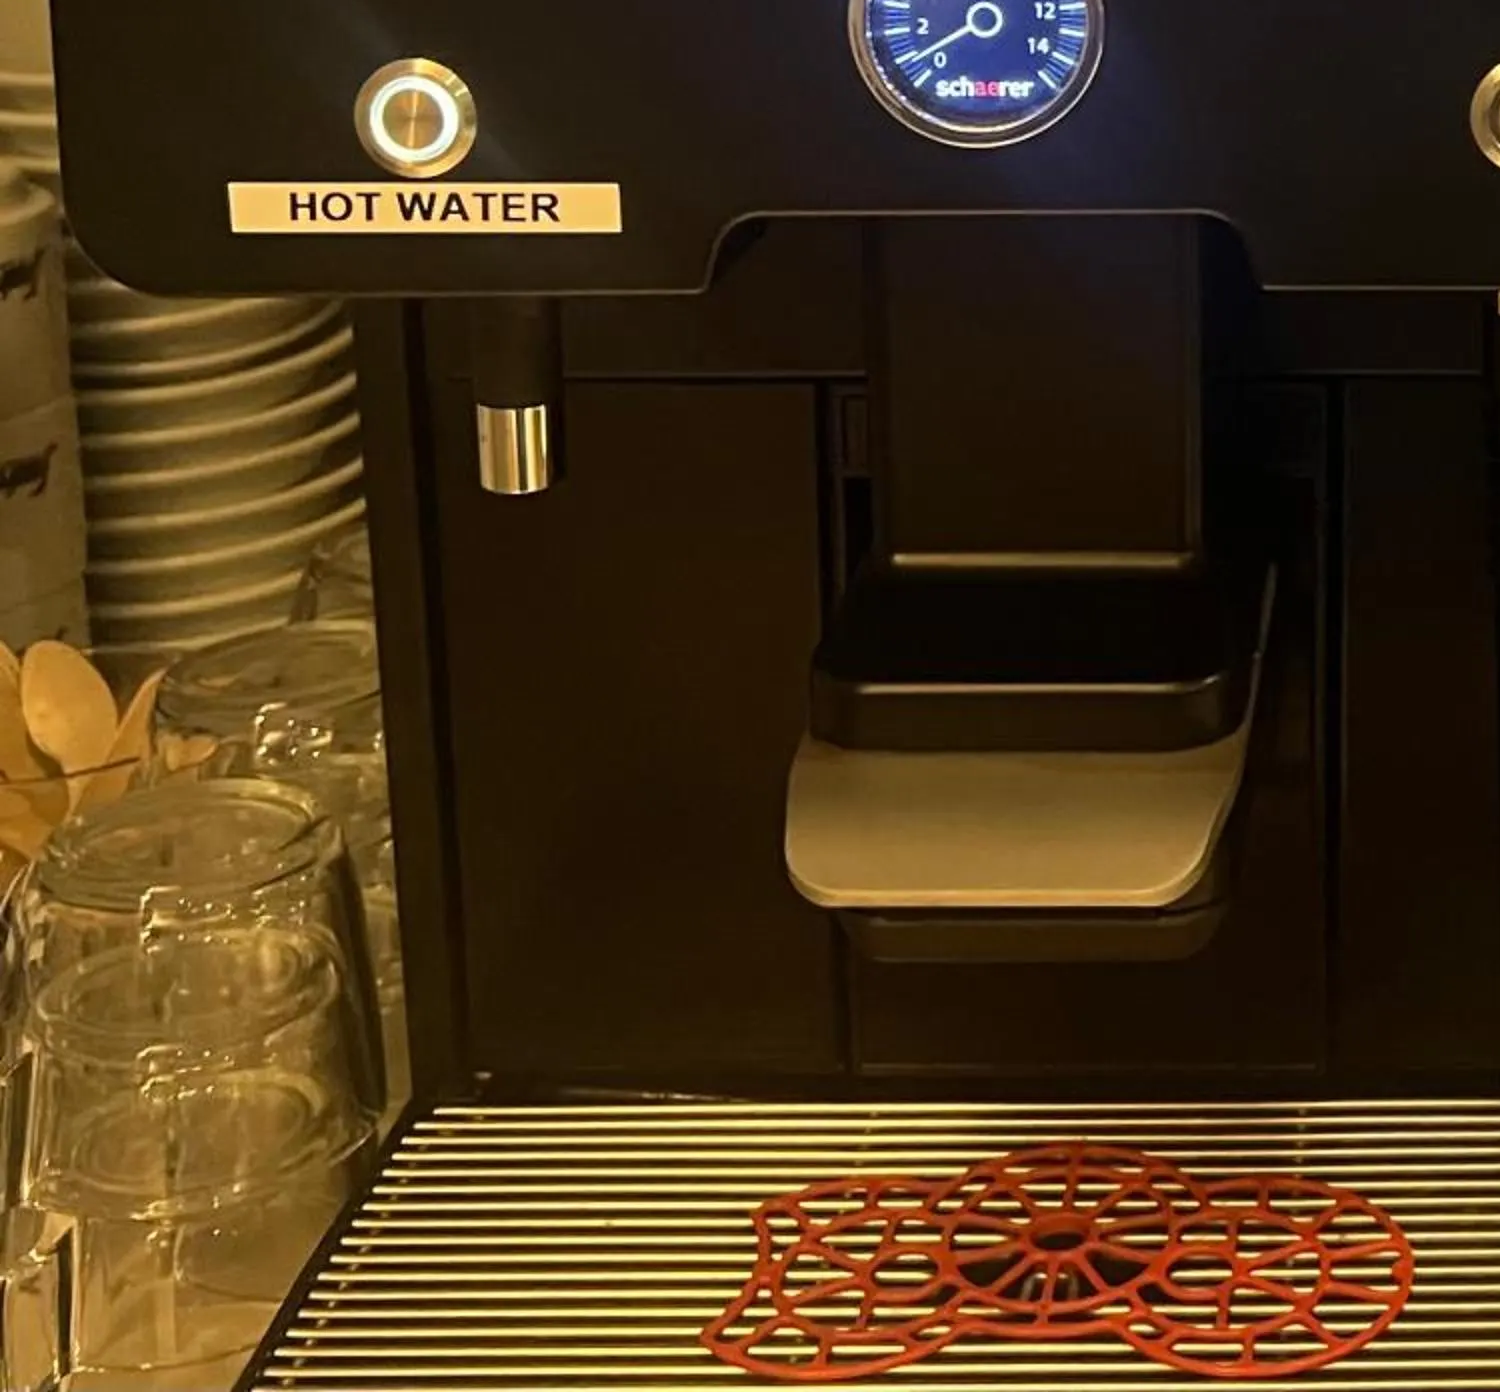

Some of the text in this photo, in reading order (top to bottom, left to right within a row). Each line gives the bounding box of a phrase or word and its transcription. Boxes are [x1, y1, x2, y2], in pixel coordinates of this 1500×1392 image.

[1034, 2, 1056, 20] 12
[917, 18, 929, 35] 2
[1028, 38, 1049, 55] 14
[934, 52, 947, 68] 0
[935, 76, 1034, 98] schaerer
[288, 192, 561, 222] HOT WATER
